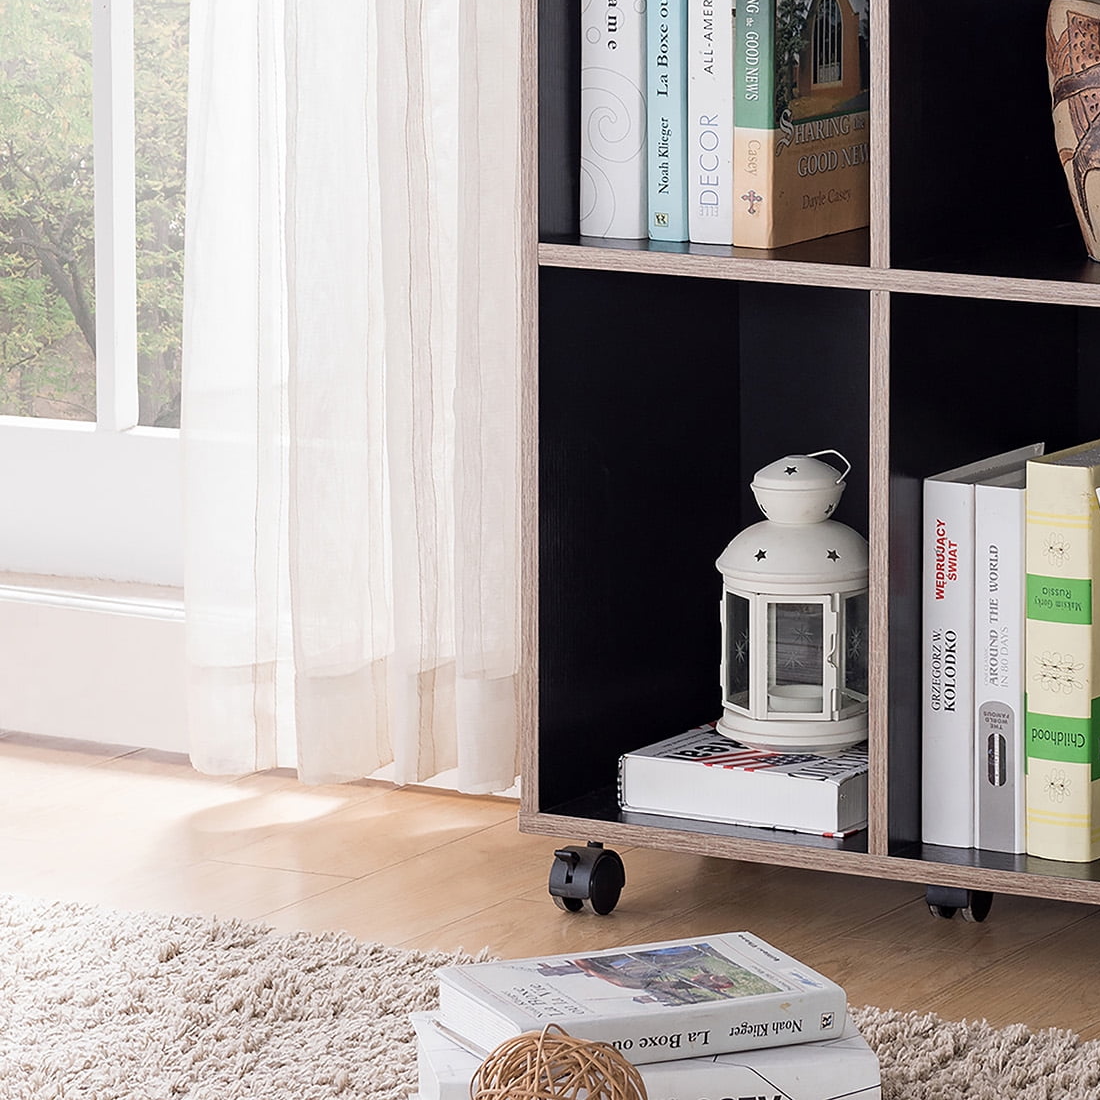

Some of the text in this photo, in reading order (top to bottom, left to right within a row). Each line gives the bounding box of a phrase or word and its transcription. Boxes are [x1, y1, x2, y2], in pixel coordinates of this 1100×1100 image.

[657, 23, 669, 68] Boxe
[745, 31, 759, 65] GOOD
[656, 73, 669, 98] La
[745, 67, 759, 101] NEWS
[776, 109, 850, 157] SHARING
[658, 117, 672, 195] Noah Klieger
[699, 114, 719, 206] DECOR
[744, 139, 761, 176] Casey
[797, 142, 870, 177] GOOD NEW
[935, 518, 948, 600] WĘDRUJĄCY
[946, 539, 958, 581] ŚWIAT
[1034, 596, 1053, 609] Gorky
[1042, 587, 1072, 599] Russia
[989, 544, 999, 687] AROUND THE WORLD
[1000, 626, 1009, 656] DAYS
[931, 628, 942, 711] GRZEGORZ W.
[1031, 727, 1085, 748] Childhood
[639, 1033, 681, 1049] Boxe
[688, 1030, 711, 1045] La
[729, 1019, 803, 1038] Noah Klieger
